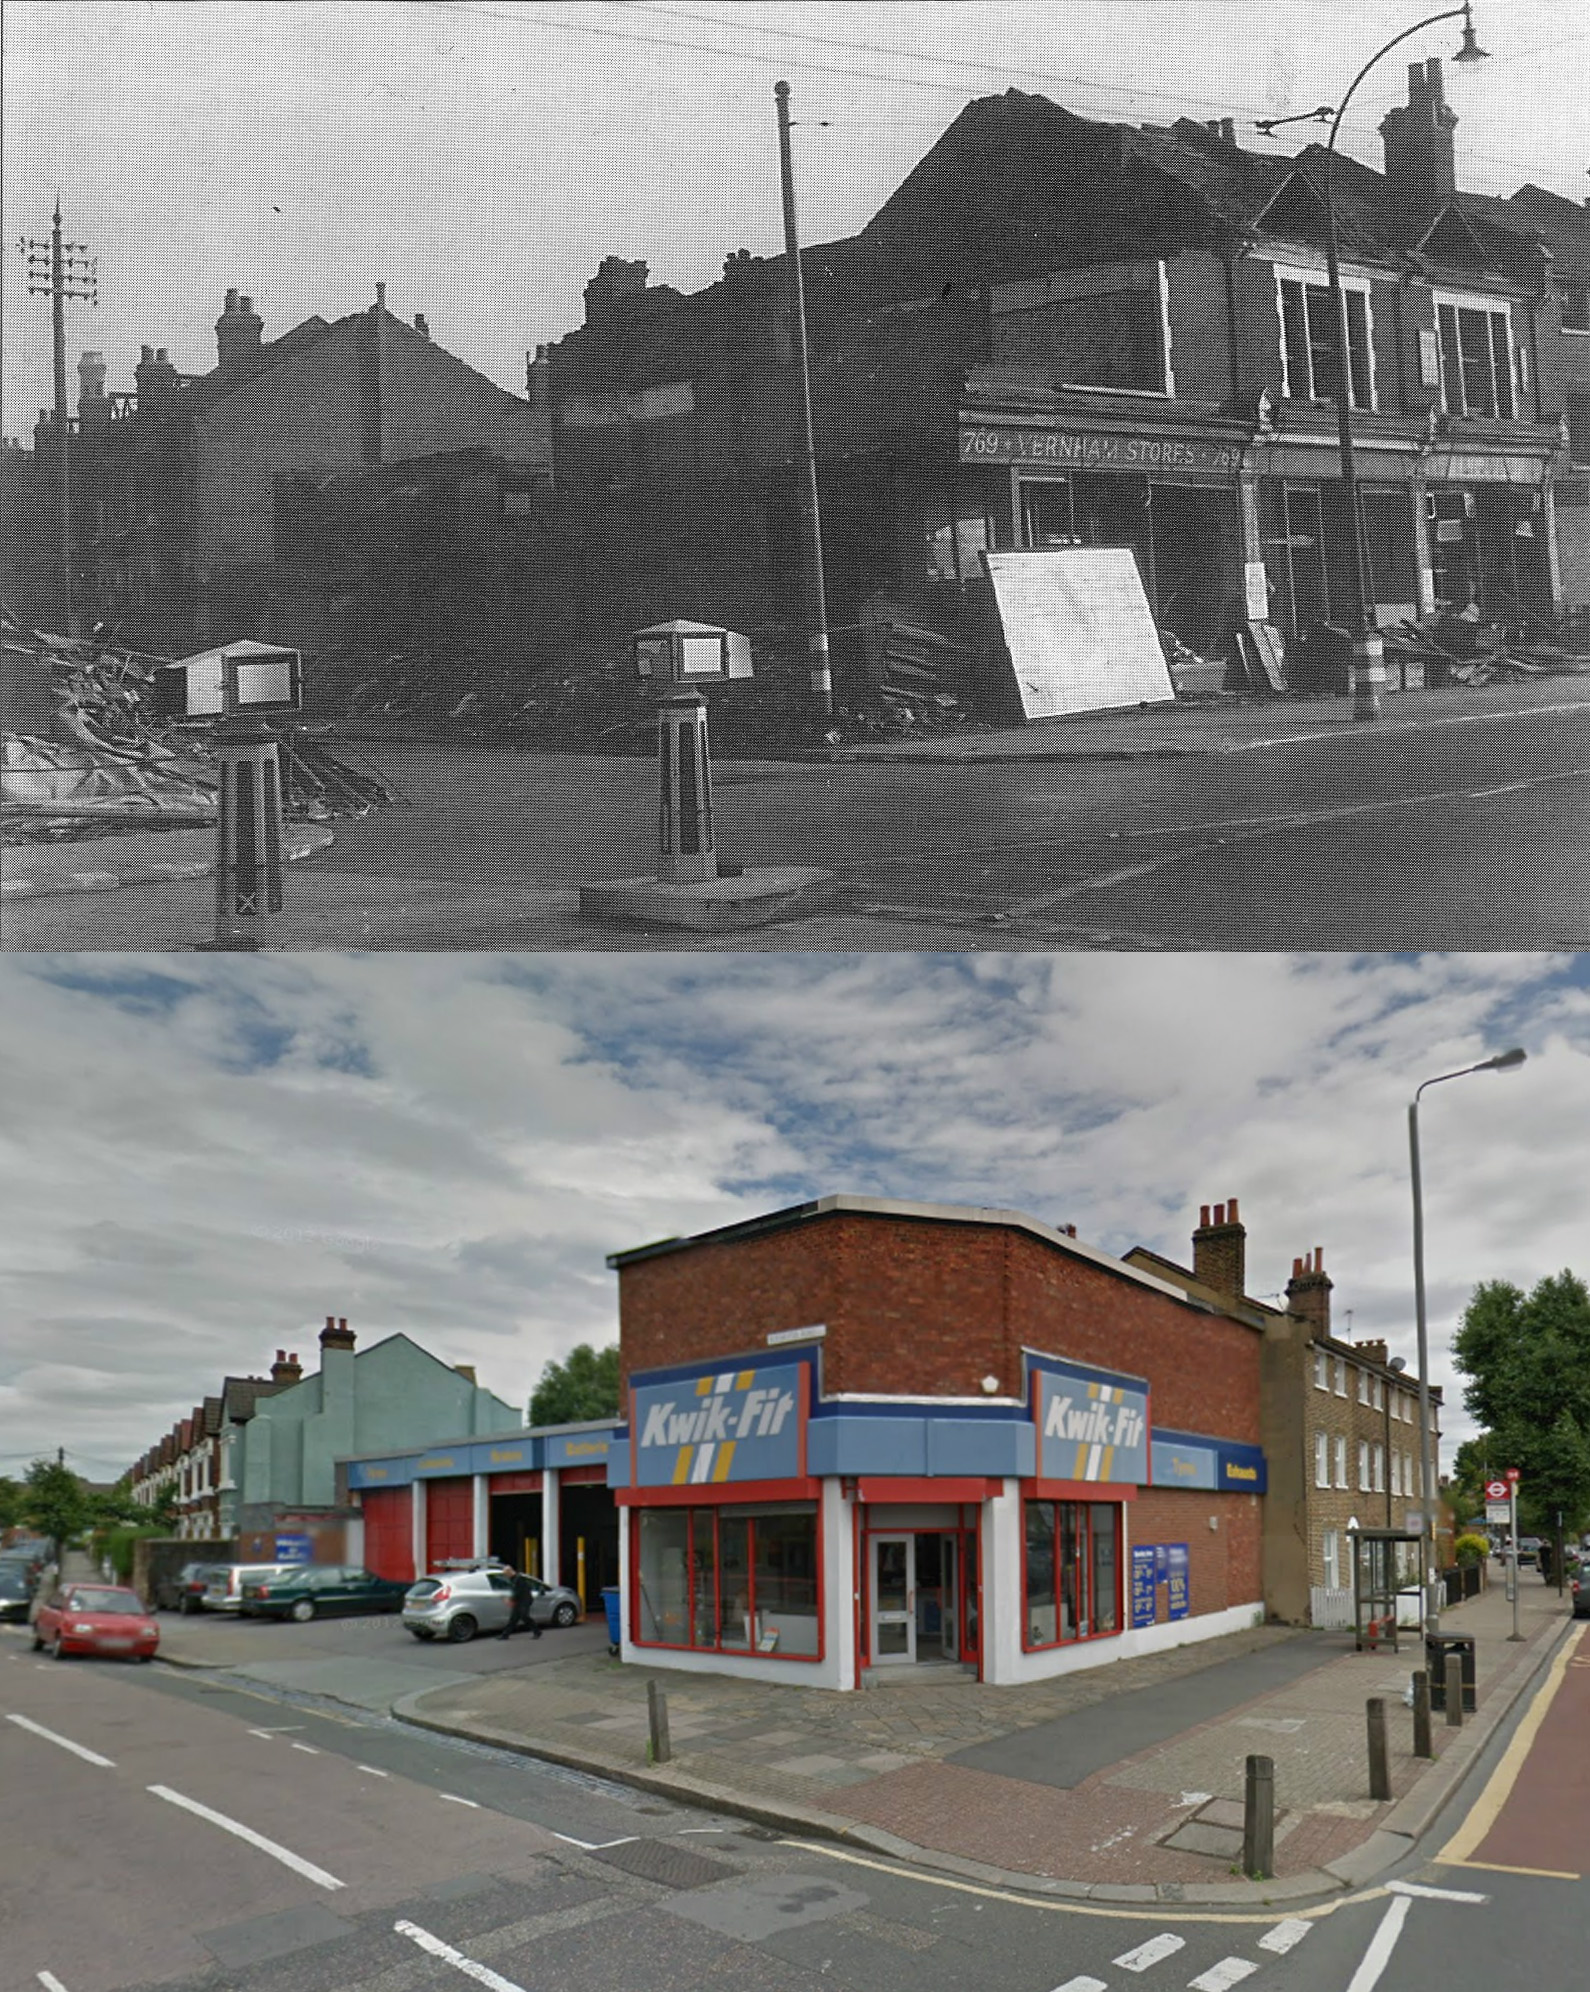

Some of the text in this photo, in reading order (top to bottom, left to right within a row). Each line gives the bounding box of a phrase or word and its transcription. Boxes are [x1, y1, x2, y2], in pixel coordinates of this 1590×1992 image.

[963, 431, 999, 454] 769
[1125, 440, 1195, 465] STORES
[640, 1387, 795, 1448] Kwik-Fit
[1044, 1395, 1144, 1448] Kwik-Fit
